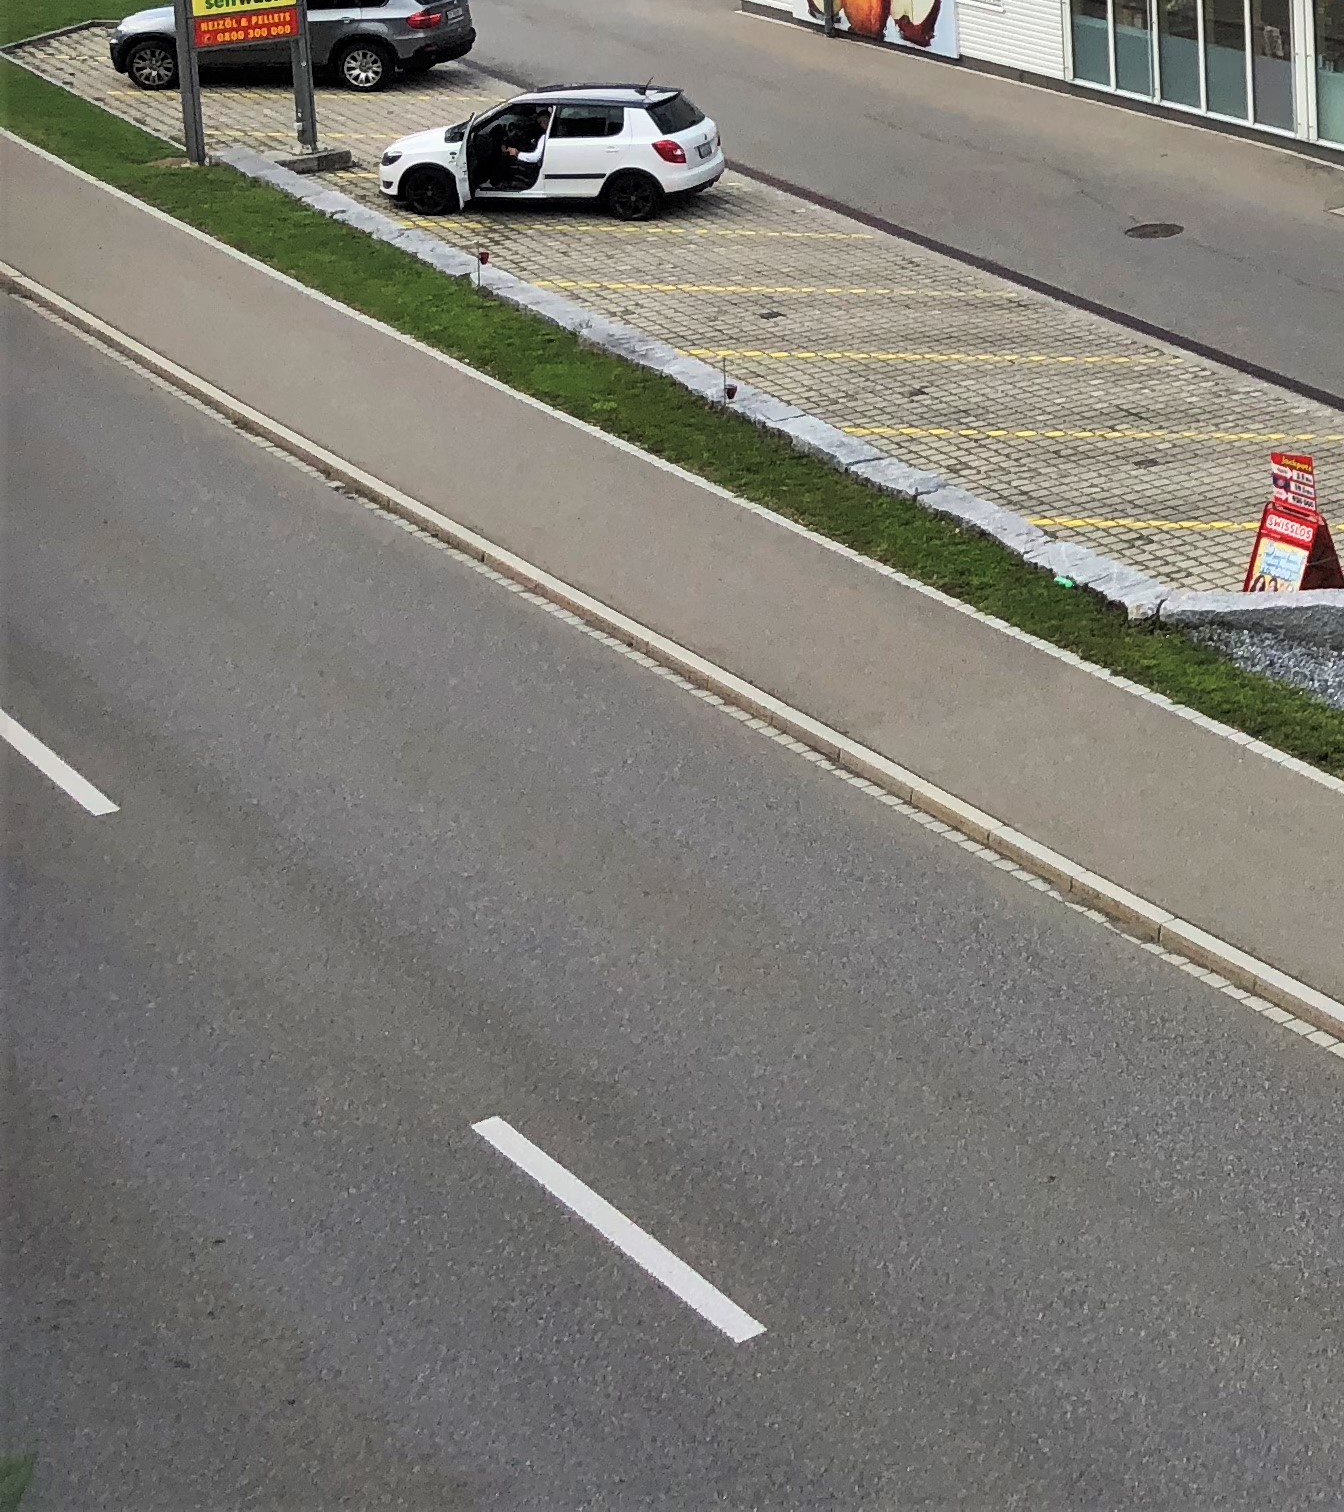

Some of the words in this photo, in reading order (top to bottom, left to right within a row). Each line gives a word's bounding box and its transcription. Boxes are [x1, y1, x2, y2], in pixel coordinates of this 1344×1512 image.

[200, 17, 238, 32] HEIZÖL
[251, 12, 291, 26] PELLETS
[217, 30, 245, 43] 0800
[248, 28, 267, 39] 300
[270, 25, 291, 36] 000
[1267, 516, 1313, 541] SWISSLOS
